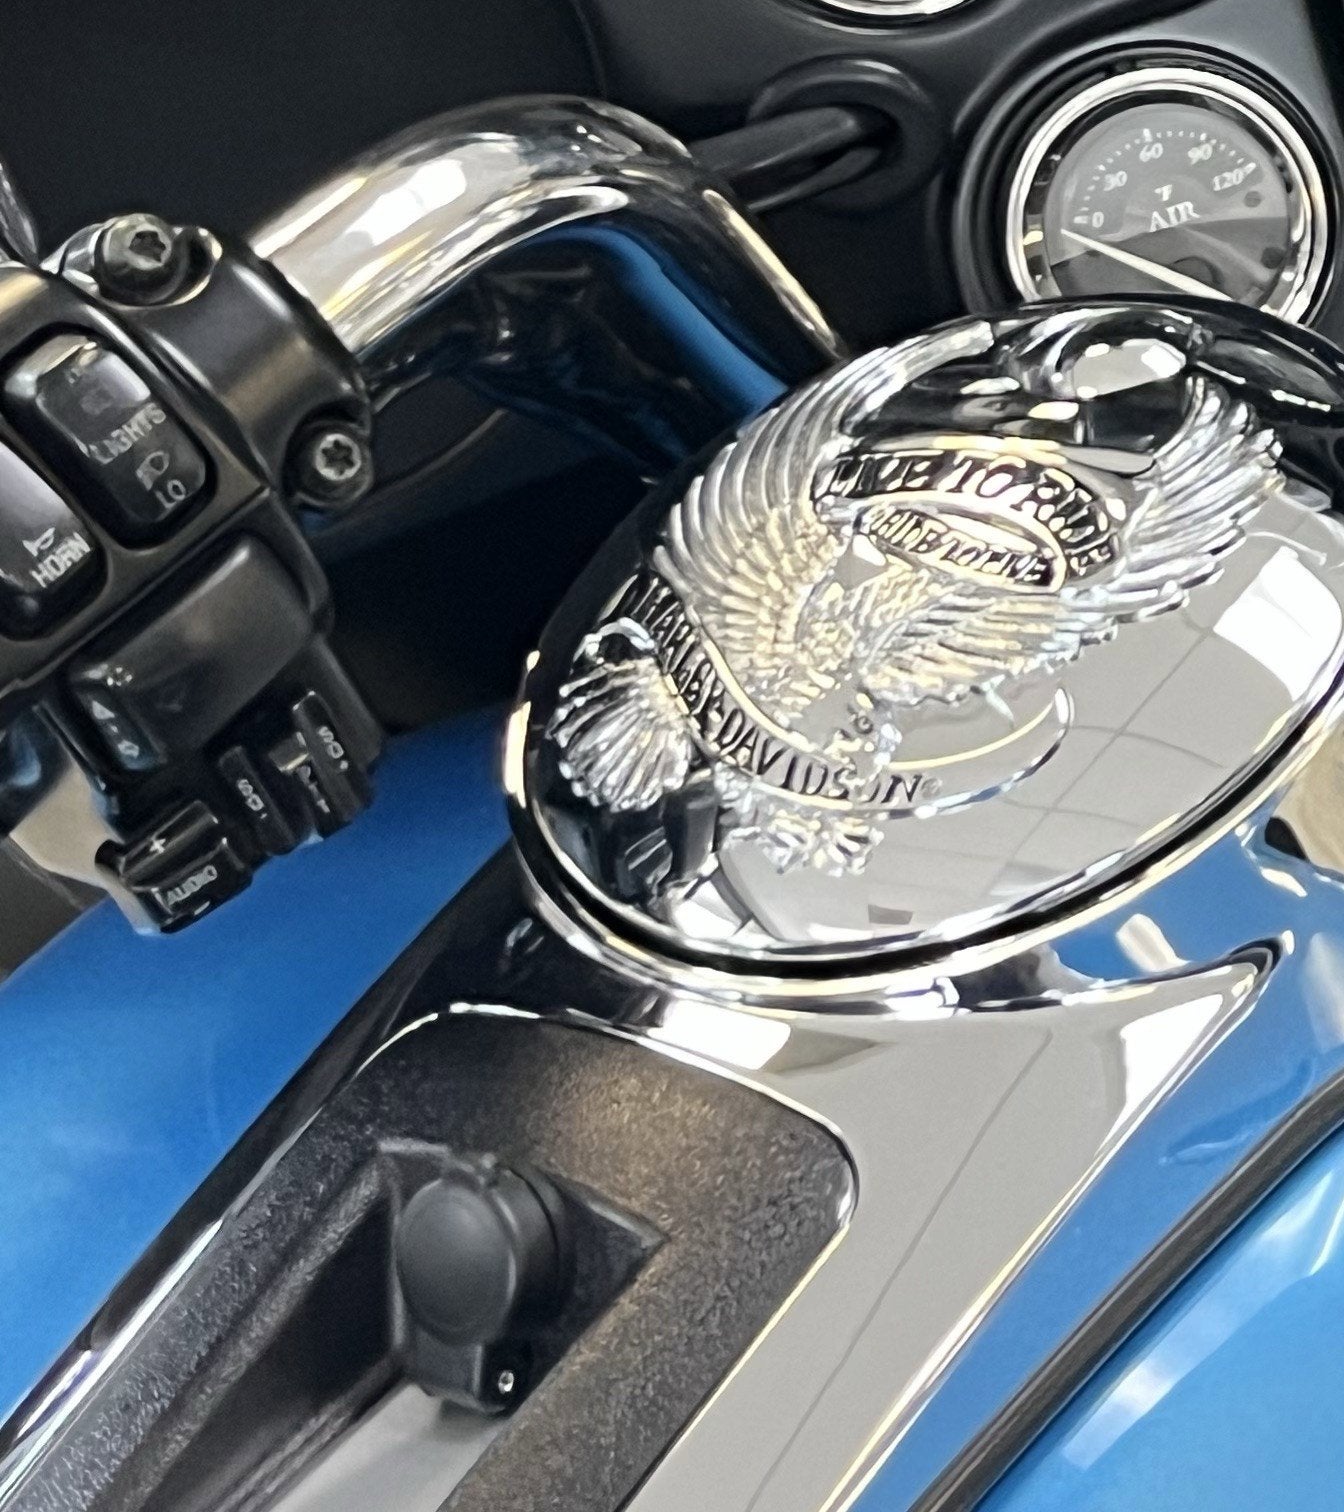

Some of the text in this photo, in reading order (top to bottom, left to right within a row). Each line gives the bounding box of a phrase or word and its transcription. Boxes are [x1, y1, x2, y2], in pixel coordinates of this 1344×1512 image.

[1140, 142, 1163, 162] 60
[1213, 170, 1244, 191] 120
[1150, 201, 1200, 232] AIR
[937, 449, 1027, 498] TO
[155, 479, 186, 509] LO
[30, 531, 91, 588] HORN
